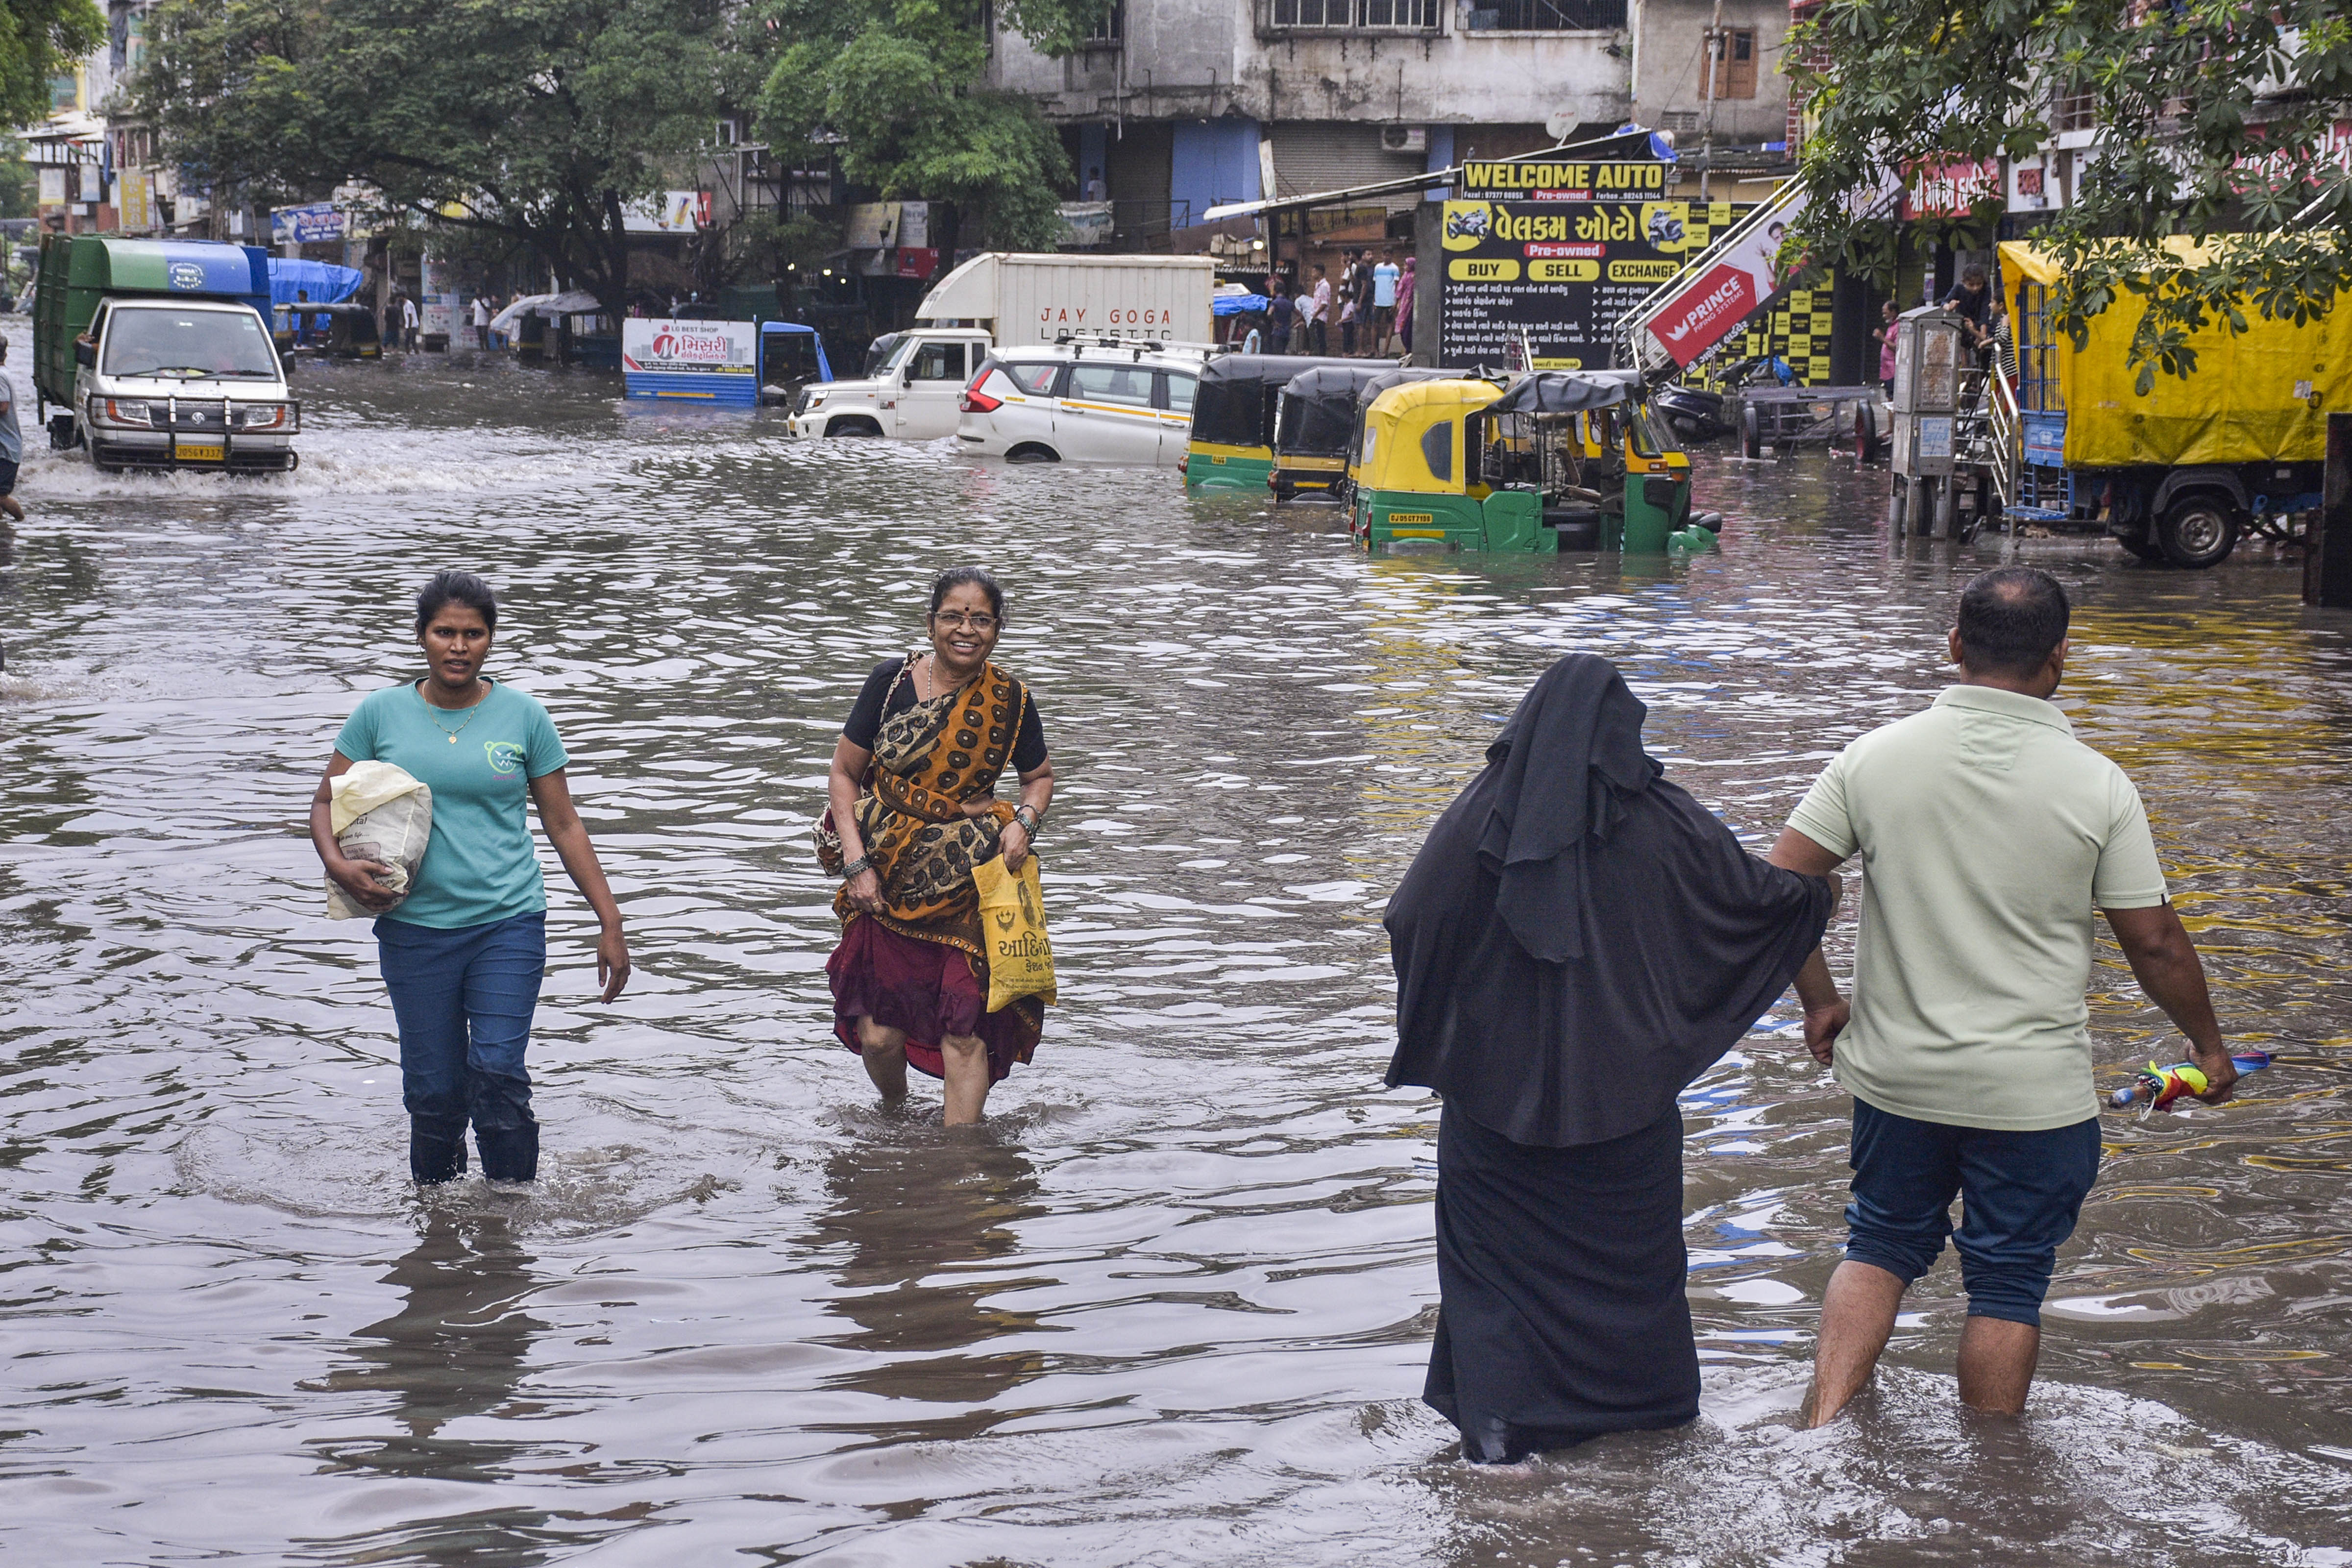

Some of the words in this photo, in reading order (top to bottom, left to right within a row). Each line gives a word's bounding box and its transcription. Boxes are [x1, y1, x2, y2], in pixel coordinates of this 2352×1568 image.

[1465, 164, 1590, 188] WELCOME
[1595, 164, 1662, 189] AUTO
[1536, 191, 1587, 200] Pre-owned
[1495, 205, 1567, 241] વેલકમ
[1575, 205, 1636, 241] ઓટો
[1529, 245, 1600, 256] Pre-owned
[1468, 264, 1500, 276] BUY
[1545, 265, 1582, 277] SELL
[1612, 265, 1675, 277] EXCHANGE
[1687, 276, 1740, 326] PRINCE
[1041, 308, 1086, 321] JAY
[1110, 309, 1170, 324] GOGA
[1693, 312, 1716, 333] PIPING
[1716, 289, 1745, 315] SYSTEMS
[682, 335, 726, 352] મિસરી
[1686, 361, 1699, 374] શ્રી
[1699, 342, 1723, 363] ગણેશ
